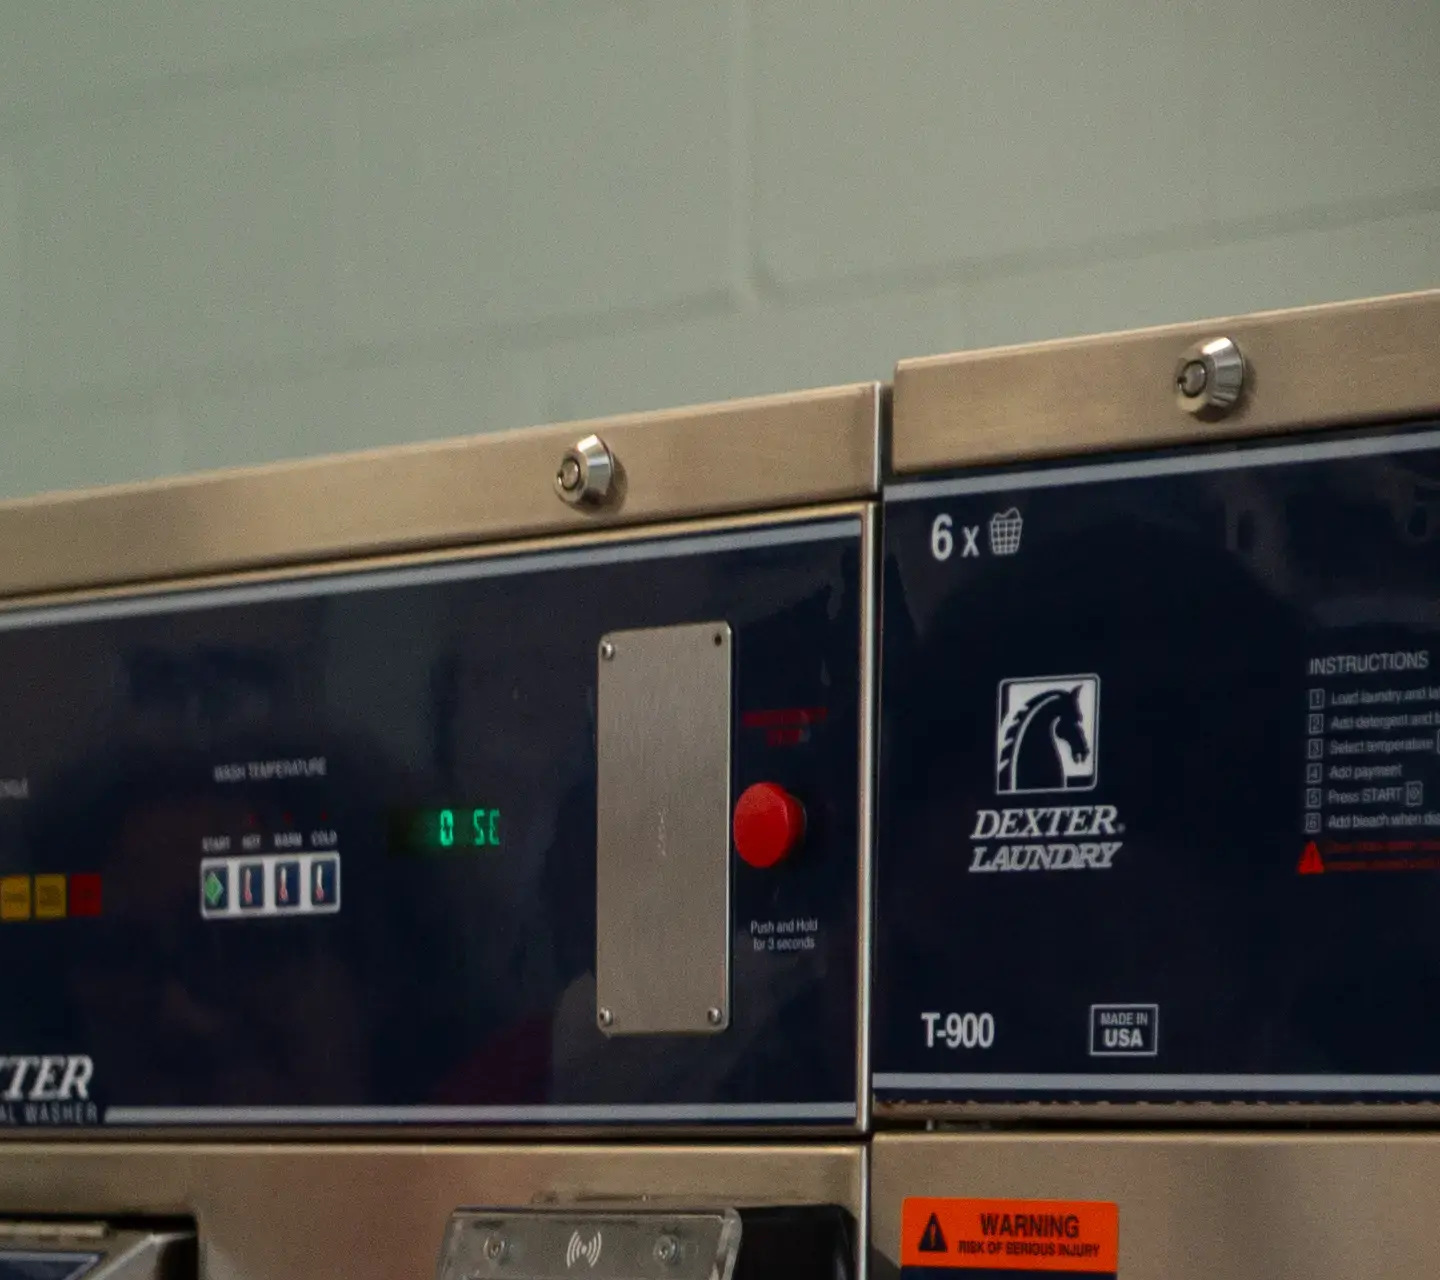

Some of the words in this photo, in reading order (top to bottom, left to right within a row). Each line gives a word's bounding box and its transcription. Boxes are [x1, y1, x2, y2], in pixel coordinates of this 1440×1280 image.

[931, 514, 953, 560] 6
[1309, 651, 1429, 675] INSTRUCTIONS
[1332, 690, 1359, 705] Load
[1361, 688, 1401, 705] laundry
[1404, 686, 1426, 701] and
[1331, 715, 1353, 729] Add
[1355, 713, 1408, 730] detergent
[1328, 765, 1352, 779] Add
[1354, 763, 1402, 781] payment
[1329, 789, 1359, 804] Press
[1362, 786, 1403, 802] START
[970, 805, 1119, 839] DEXTER
[1329, 814, 1352, 828] Add
[1353, 812, 1389, 828] bleach
[1391, 812, 1422, 827] when
[968, 842, 1123, 872] LAUNDRY
[750, 920, 774, 934] Push
[776, 919, 794, 933] and
[796, 918, 818, 932] Hold
[753, 937, 766, 950] for
[768, 937, 775, 950] 3
[777, 935, 815, 949] seconds
[1101, 1012, 1134, 1026] MADE
[1136, 1012, 1148, 1025] IN
[921, 1012, 995, 1048] T-900
[1104, 1029, 1143, 1047] USA
[25, 1101, 98, 1124] WASHER
[980, 1213, 1079, 1238] WARNING
[958, 1240, 984, 1254] RISK
[987, 1241, 1004, 1255] OF
[1006, 1241, 1056, 1257] SERIOUS
[1058, 1243, 1100, 1258] INJURY
